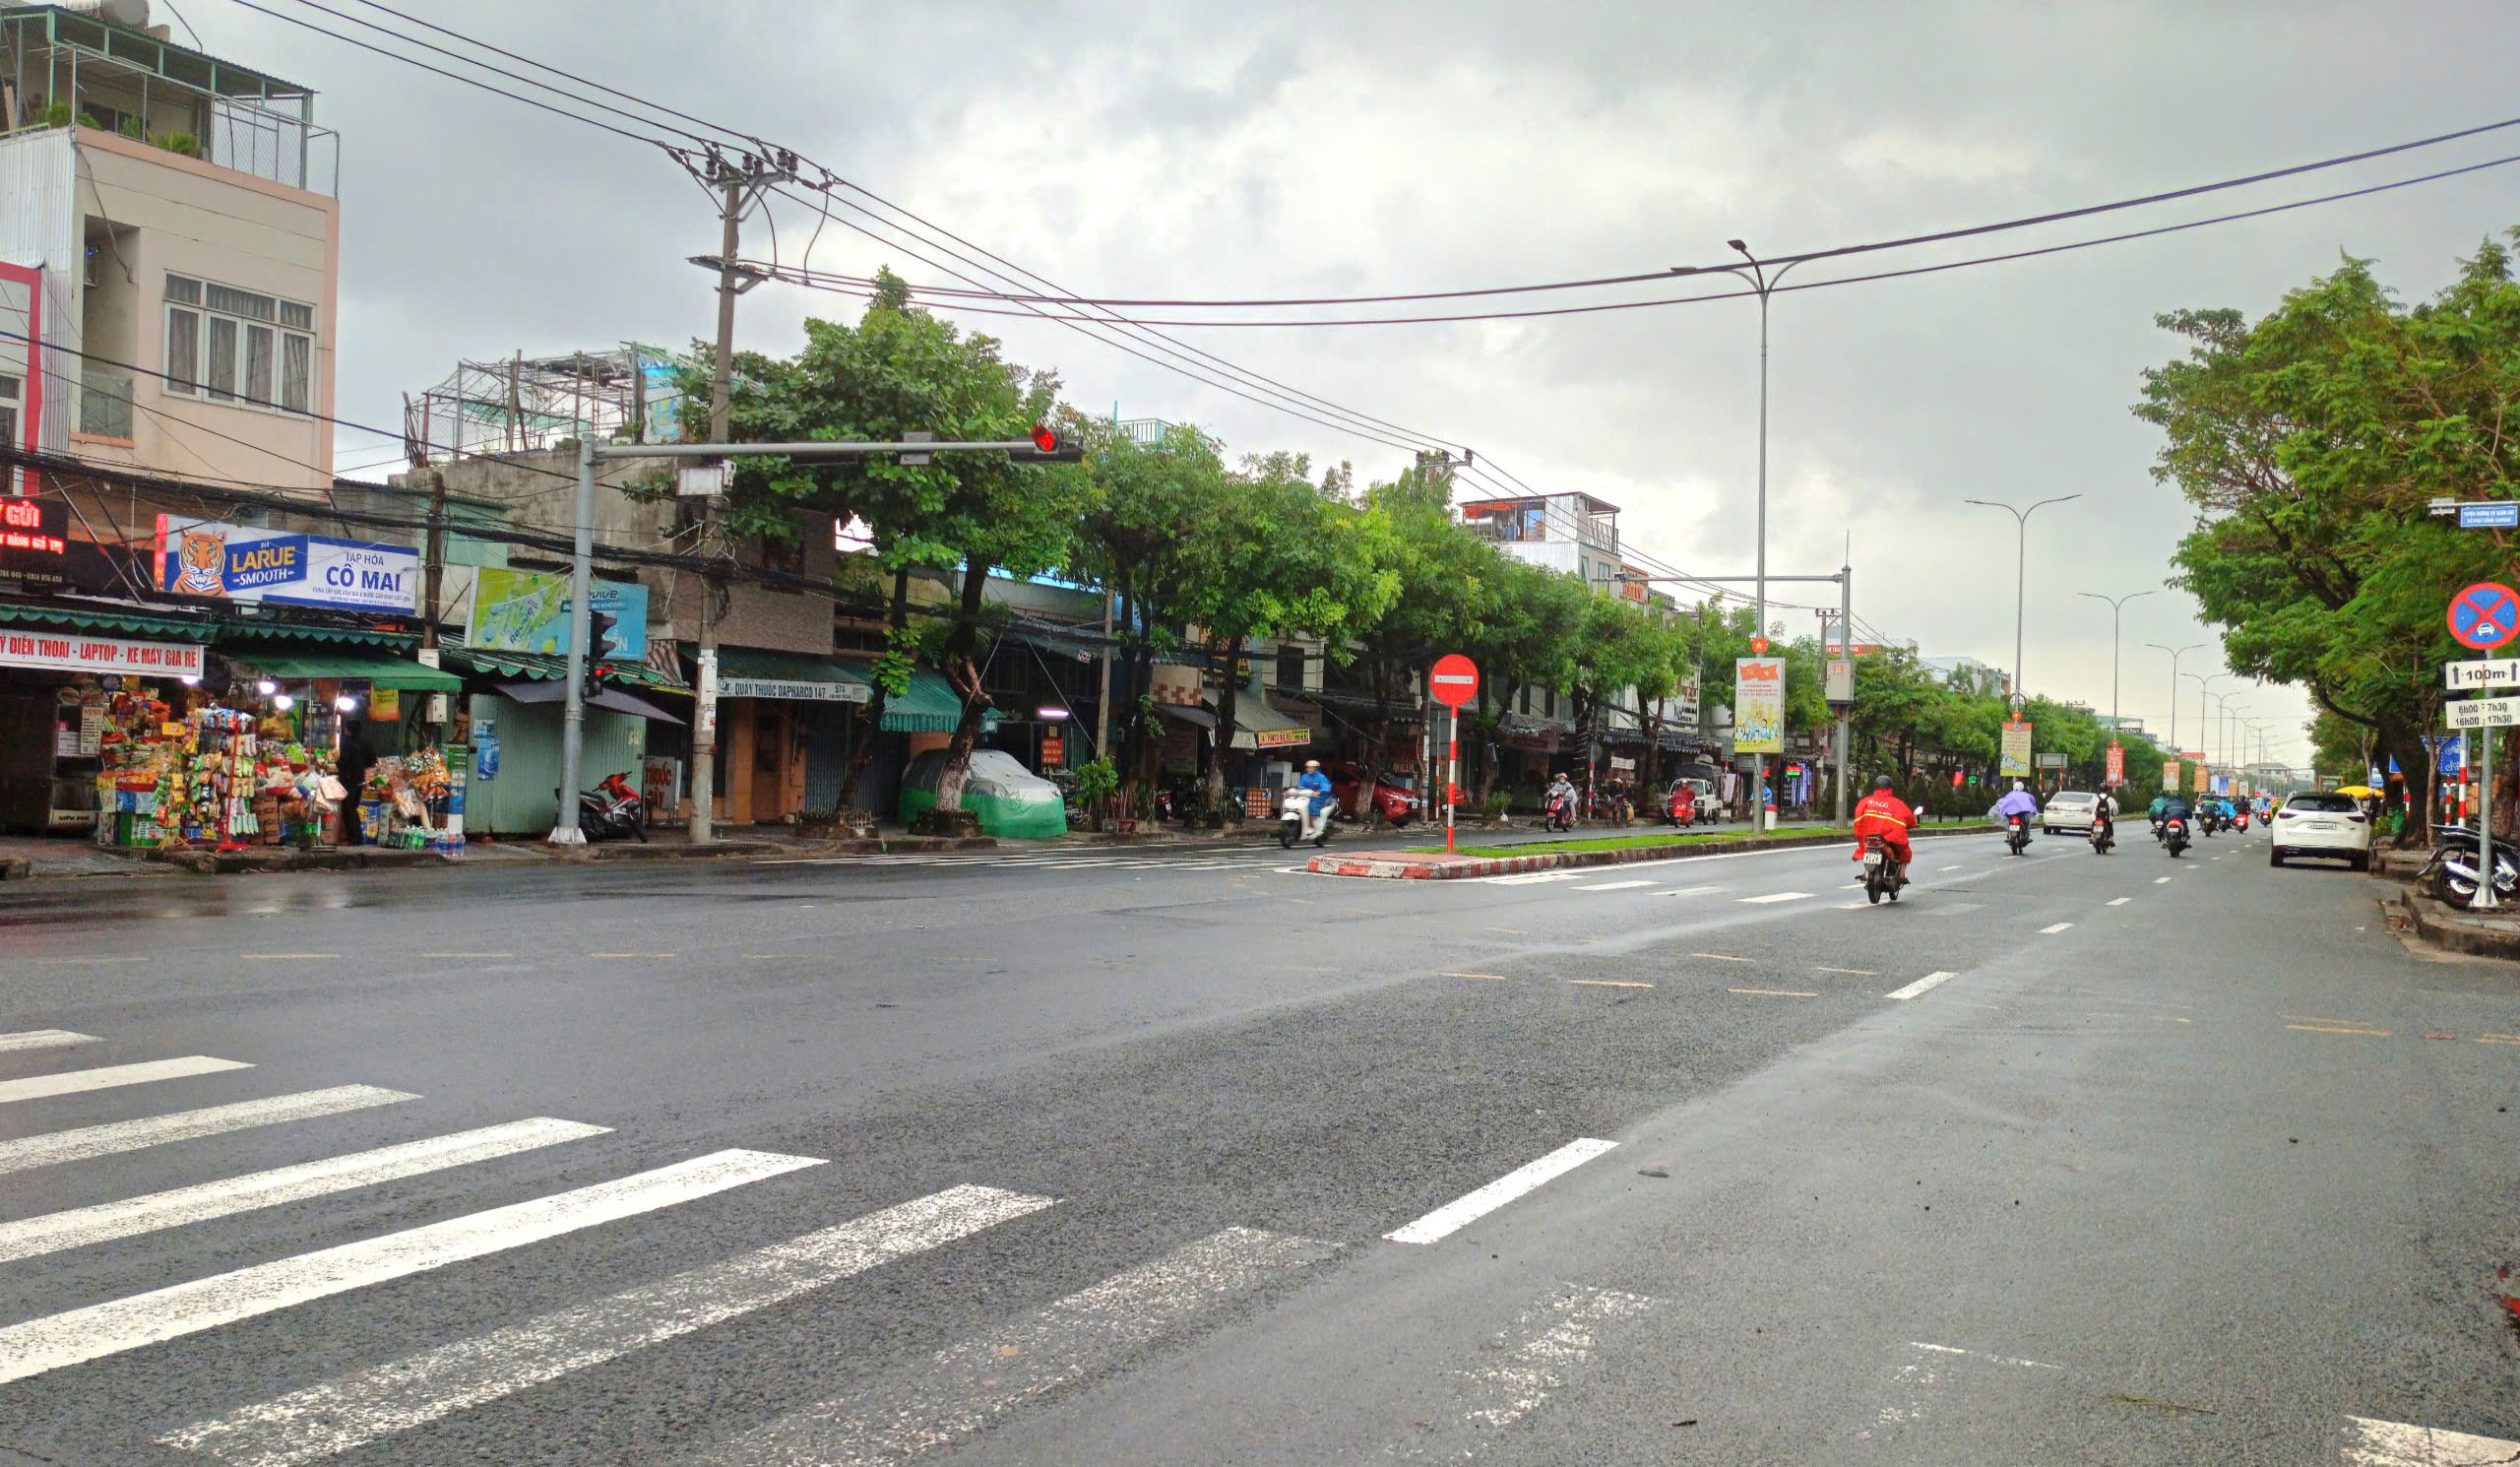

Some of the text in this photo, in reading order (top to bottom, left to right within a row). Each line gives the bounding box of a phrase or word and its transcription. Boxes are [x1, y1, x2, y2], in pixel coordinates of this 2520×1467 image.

[232, 545, 296, 572] LARUE
[239, 567, 287, 586] SMOOTH
[326, 562, 401, 592] CÔ MAI
[37, 639, 71, 661] THOẠI
[80, 642, 117, 662] LAPTOP
[127, 645, 139, 663] XE
